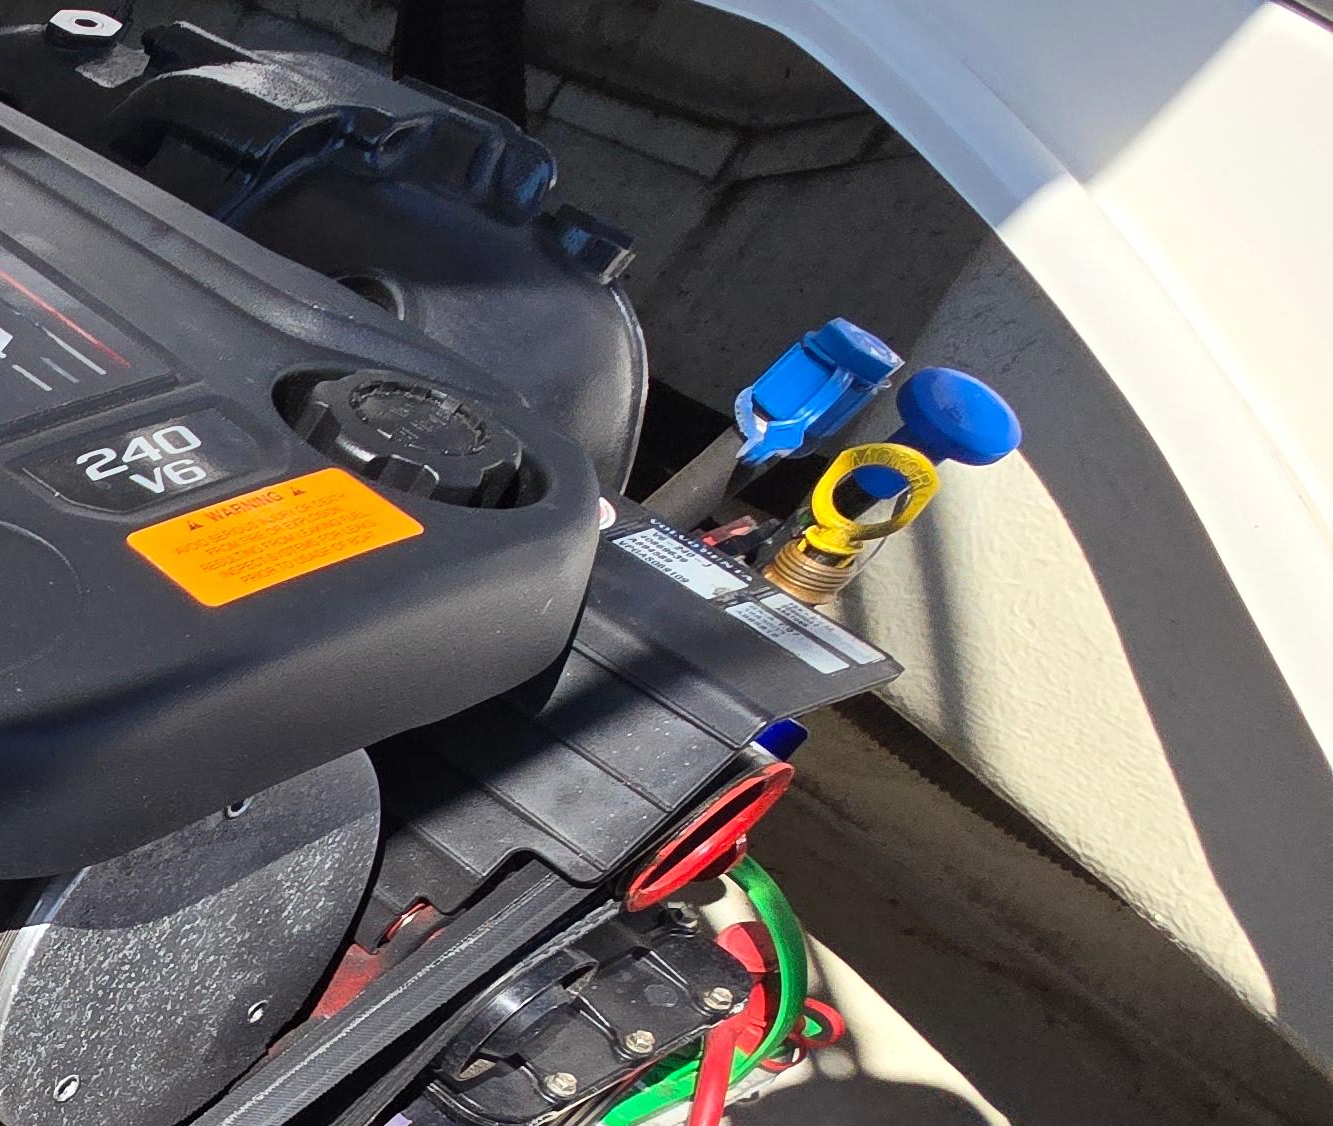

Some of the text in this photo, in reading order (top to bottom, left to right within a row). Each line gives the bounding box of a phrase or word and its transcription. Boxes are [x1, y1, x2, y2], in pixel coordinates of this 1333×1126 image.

[76, 424, 203, 483] 240
[129, 459, 207, 495] V6
[207, 491, 284, 522] WARNING
[210, 522, 259, 541] SERIOUS
[259, 509, 296, 525] INJURY
[295, 502, 313, 513] OR
[204, 540, 239, 557] FROM
[238, 532, 265, 545] FIRE
[264, 524, 283, 536] OR
[260, 535, 296, 551] FROM
